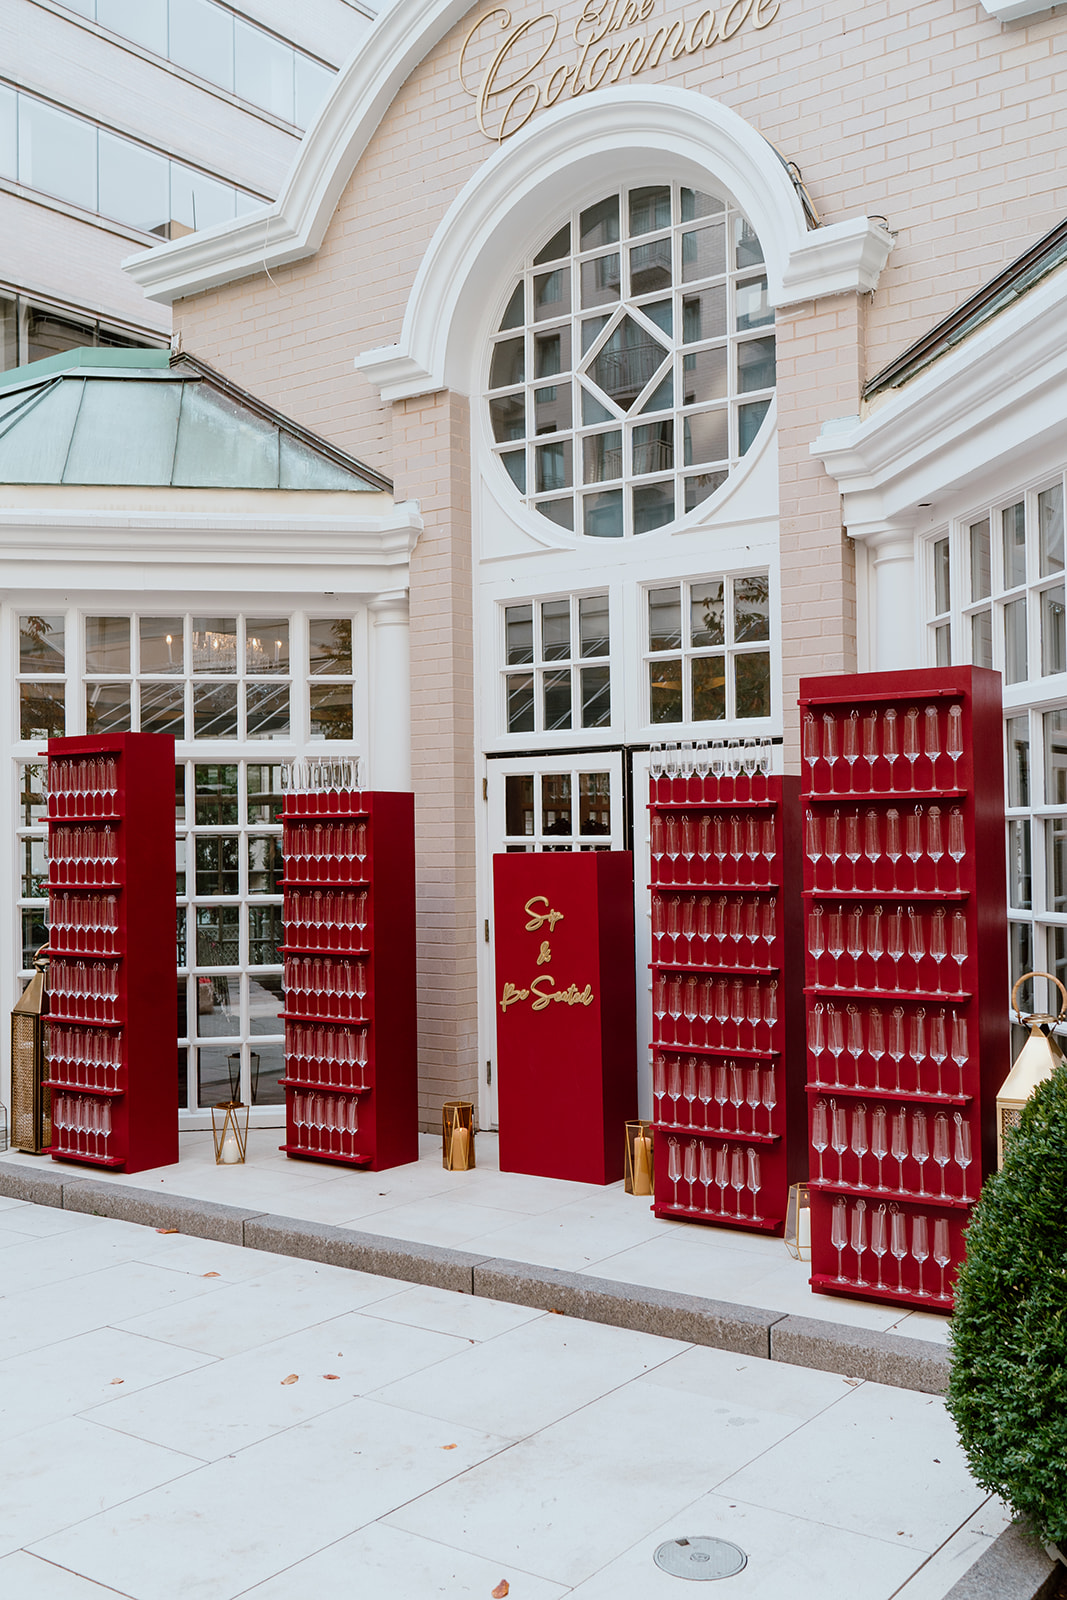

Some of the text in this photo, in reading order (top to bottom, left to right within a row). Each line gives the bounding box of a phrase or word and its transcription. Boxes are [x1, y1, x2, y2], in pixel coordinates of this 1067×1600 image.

[573, 0, 655, 47] The
[524, 895, 564, 932] Sip
[536, 940, 552, 966] &
[499, 974, 594, 1013] Be Seated
